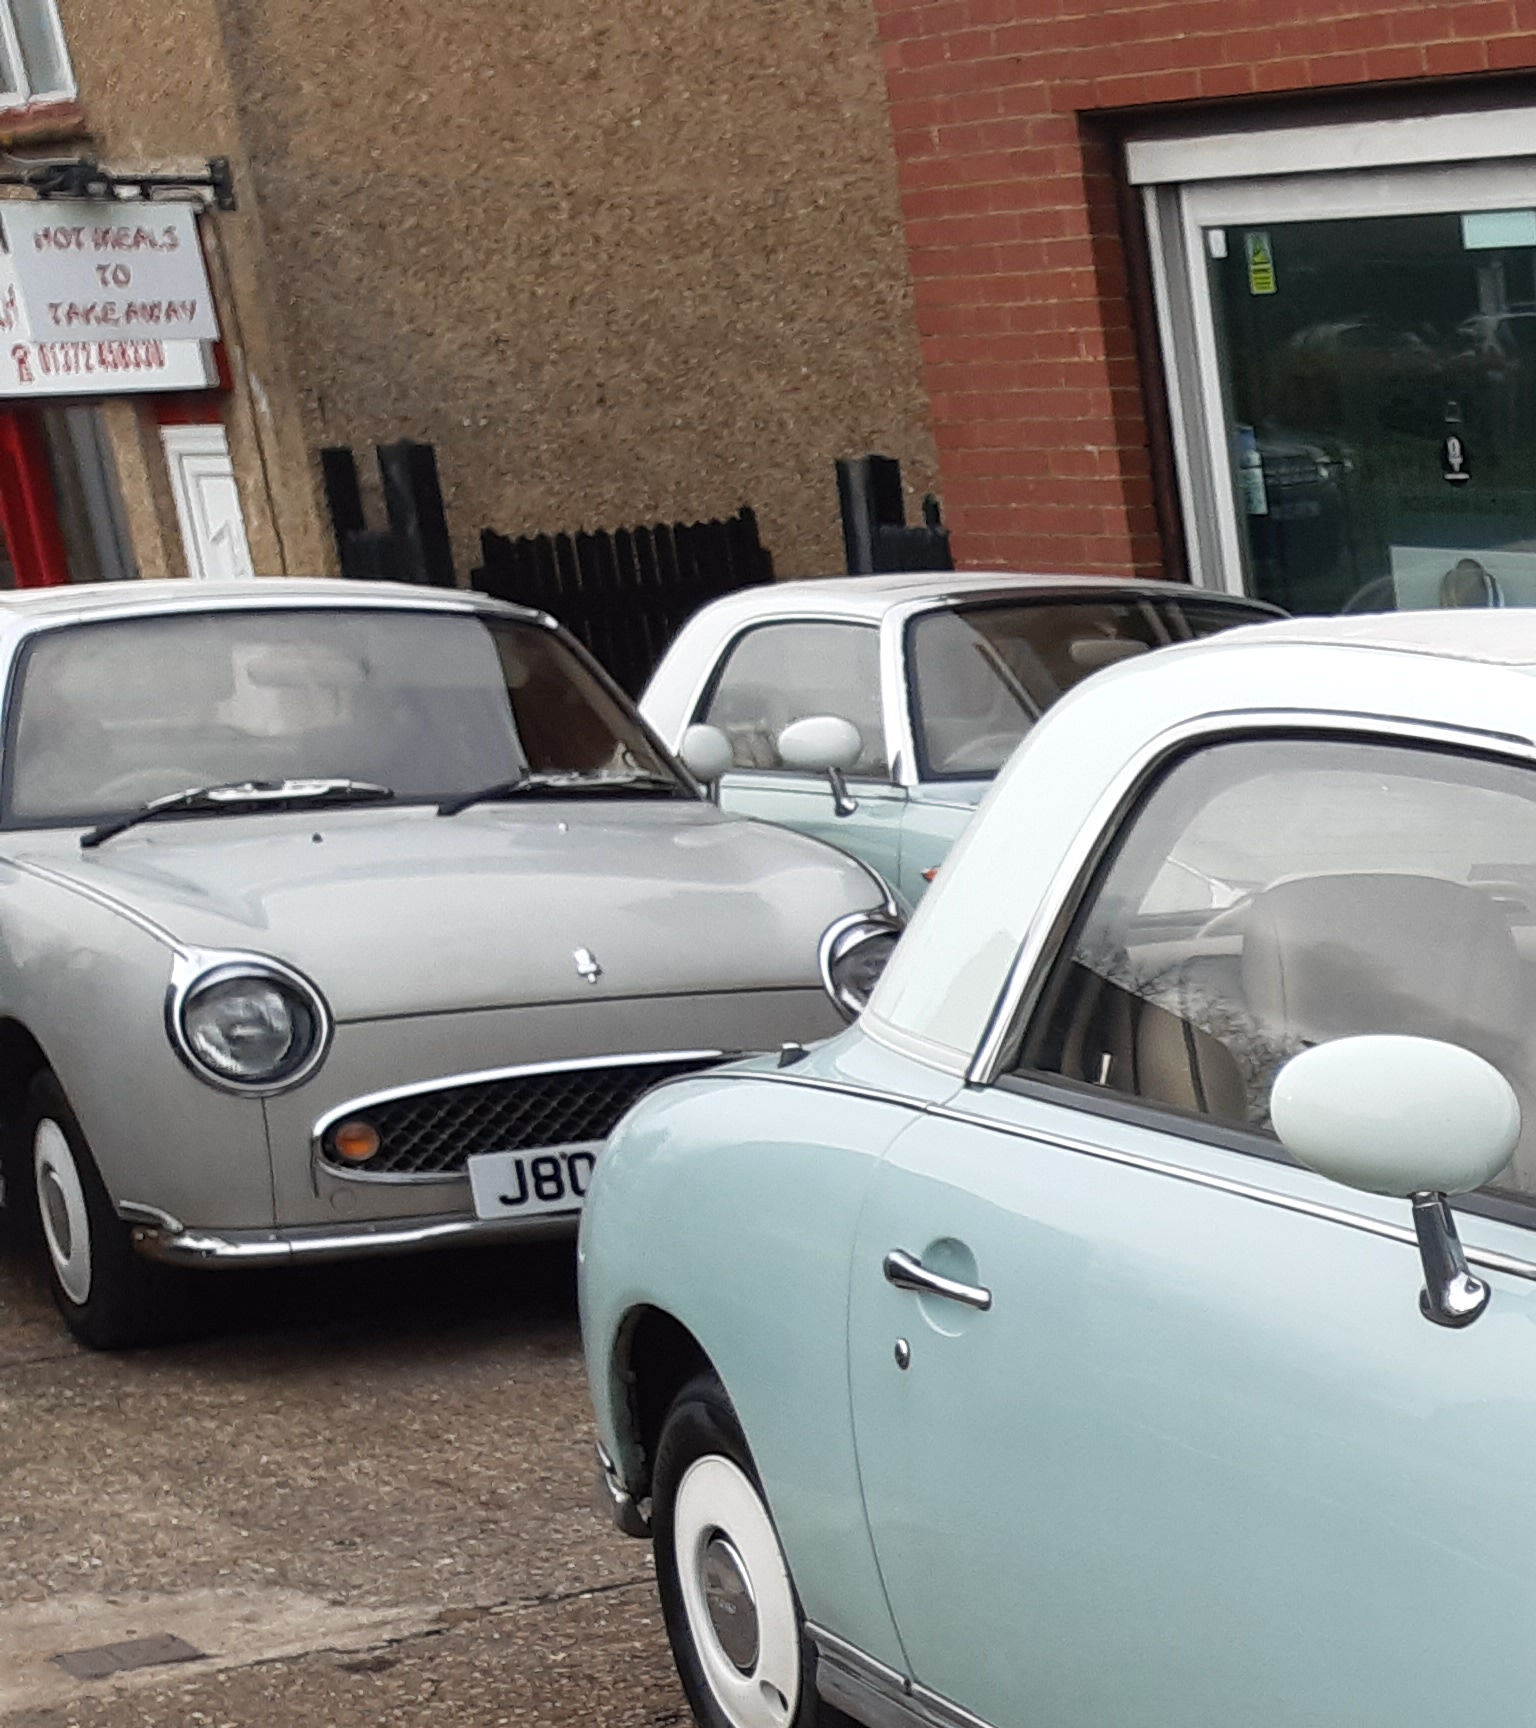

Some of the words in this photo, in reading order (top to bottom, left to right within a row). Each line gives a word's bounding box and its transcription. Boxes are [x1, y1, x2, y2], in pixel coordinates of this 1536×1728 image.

[34, 226, 85, 250] HOT
[92, 225, 180, 250] MEALS
[95, 262, 131, 287] TO
